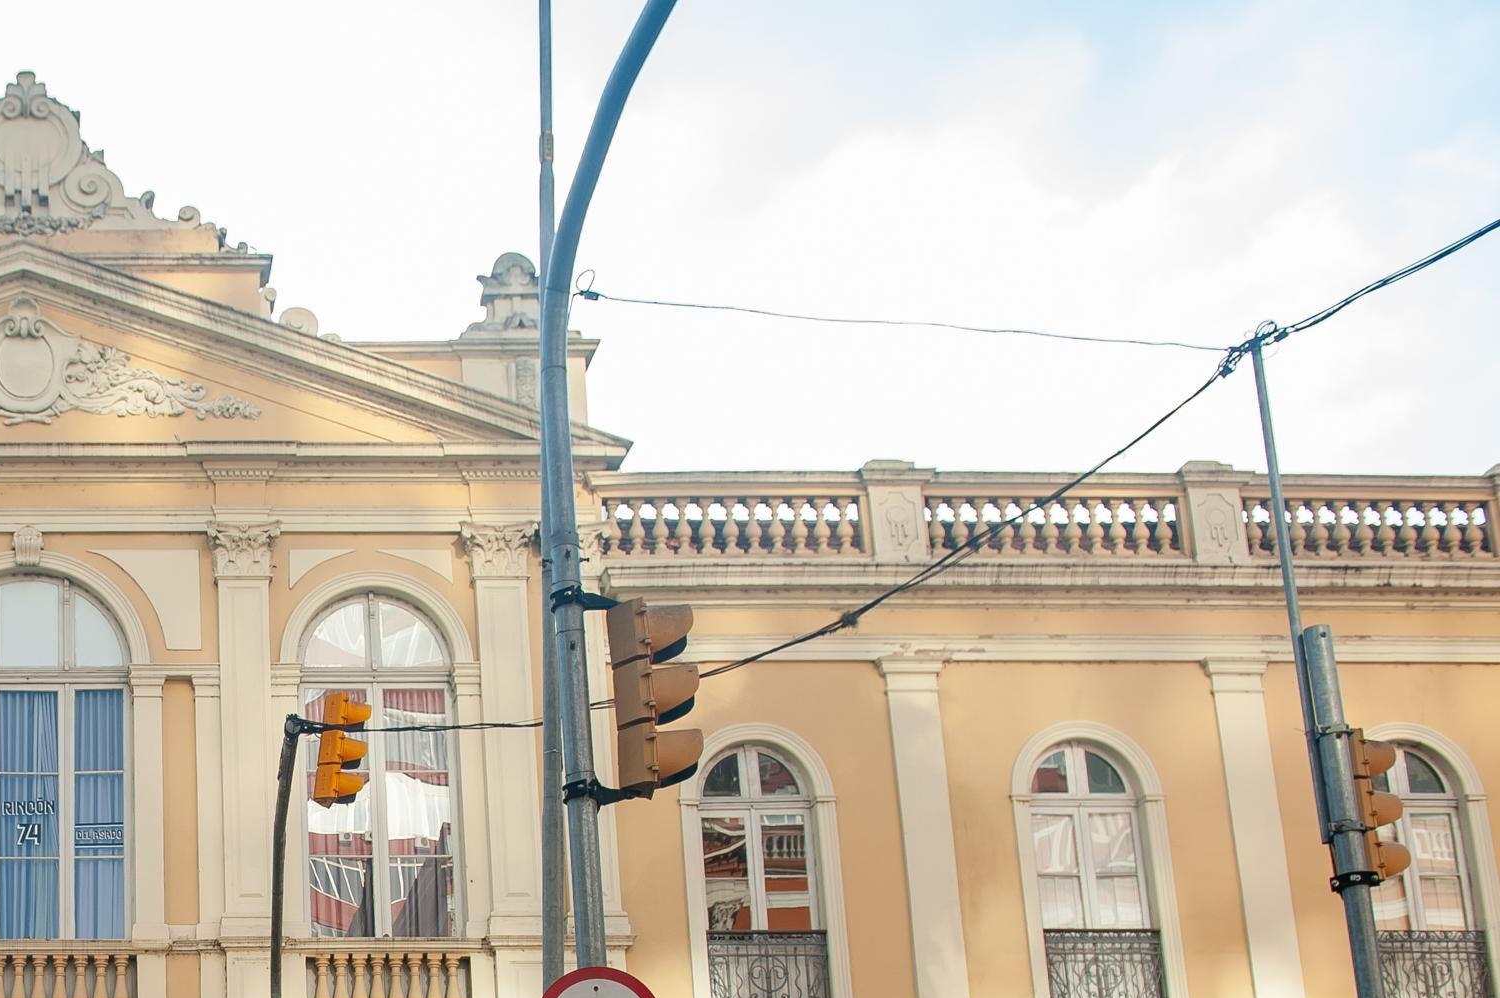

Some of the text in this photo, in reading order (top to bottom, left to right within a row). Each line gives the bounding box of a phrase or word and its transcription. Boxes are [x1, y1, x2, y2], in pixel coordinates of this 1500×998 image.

[16, 824, 42, 846] 74
[75, 829, 123, 840] DEL ASADO
